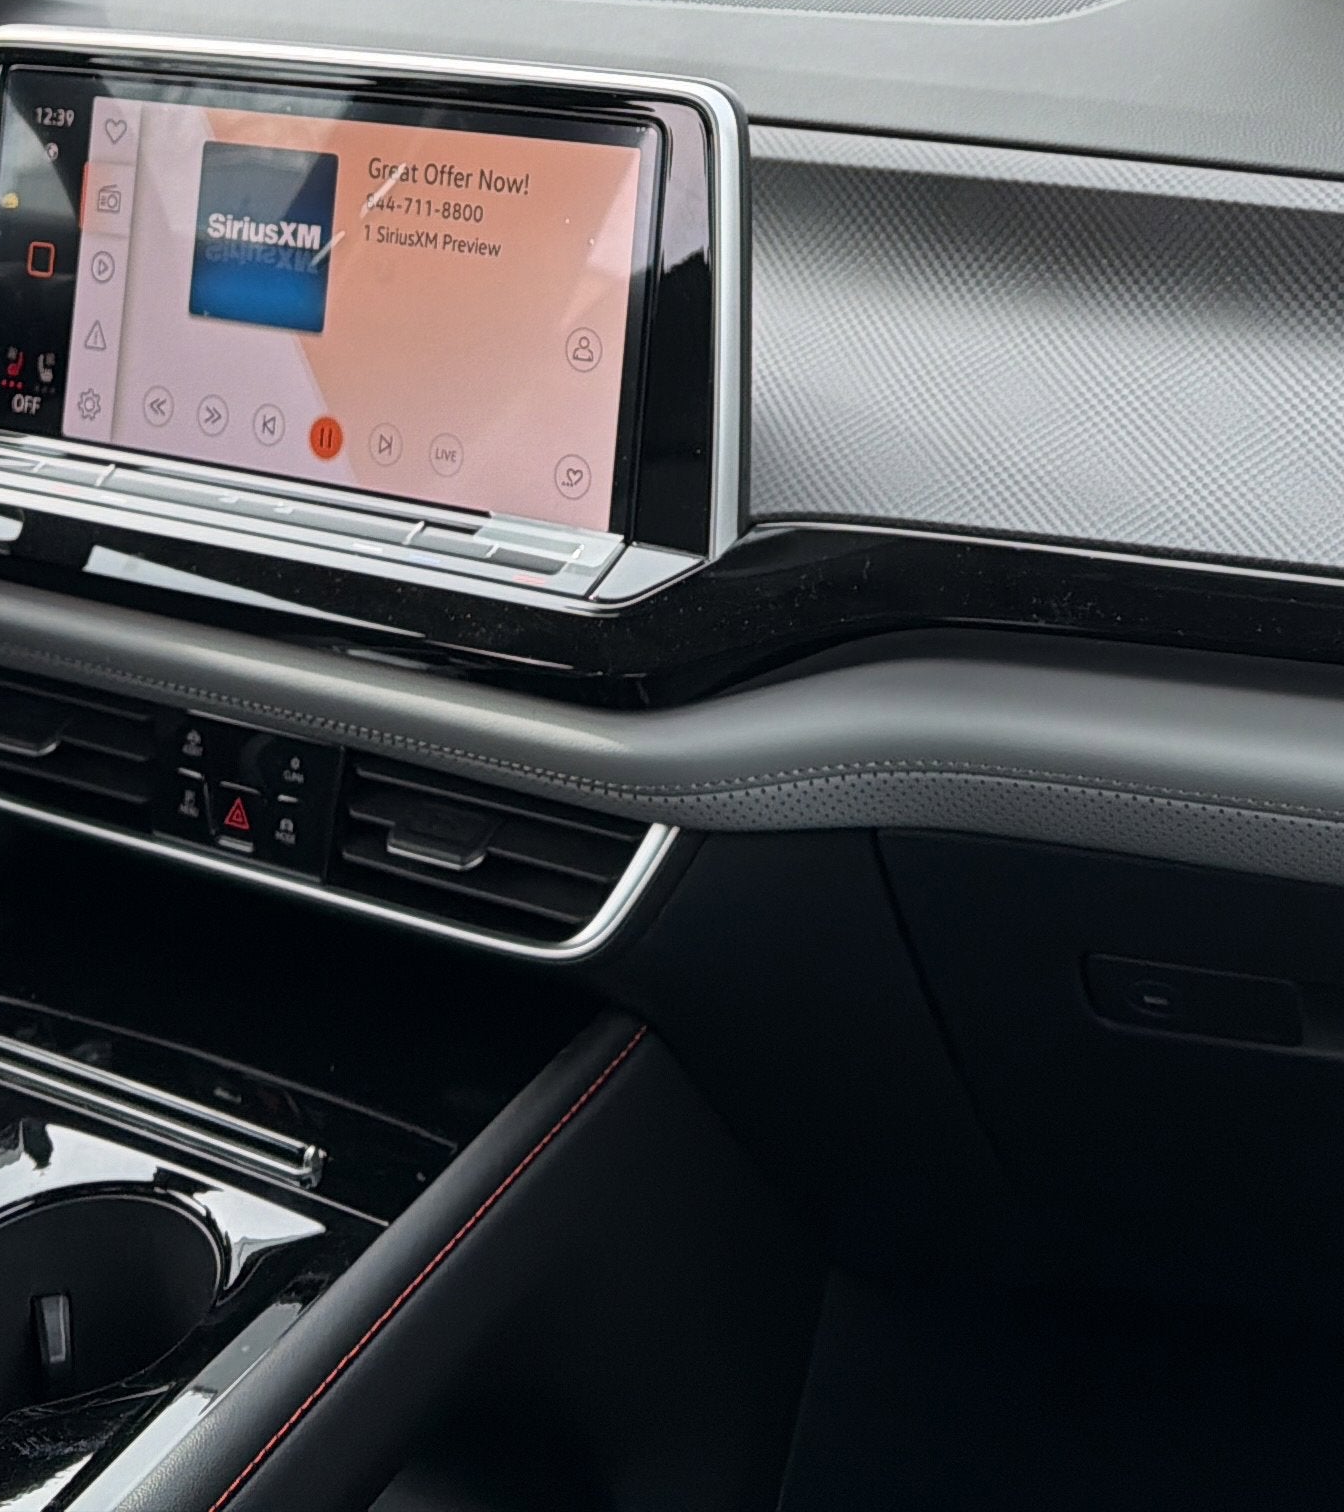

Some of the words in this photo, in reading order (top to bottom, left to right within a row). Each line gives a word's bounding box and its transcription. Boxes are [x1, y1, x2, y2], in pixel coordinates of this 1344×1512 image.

[36, 107, 75, 128] 12:39
[368, 157, 419, 184] Great
[423, 162, 474, 189] Offer
[478, 169, 531, 196] Now!
[366, 193, 485, 224] 844-711-8800
[207, 212, 322, 251] SiriusXM
[376, 226, 439, 251] SiriusXM
[441, 234, 503, 258] Preview
[11, 393, 42, 416] OFF
[435, 447, 457, 464] LIVE
